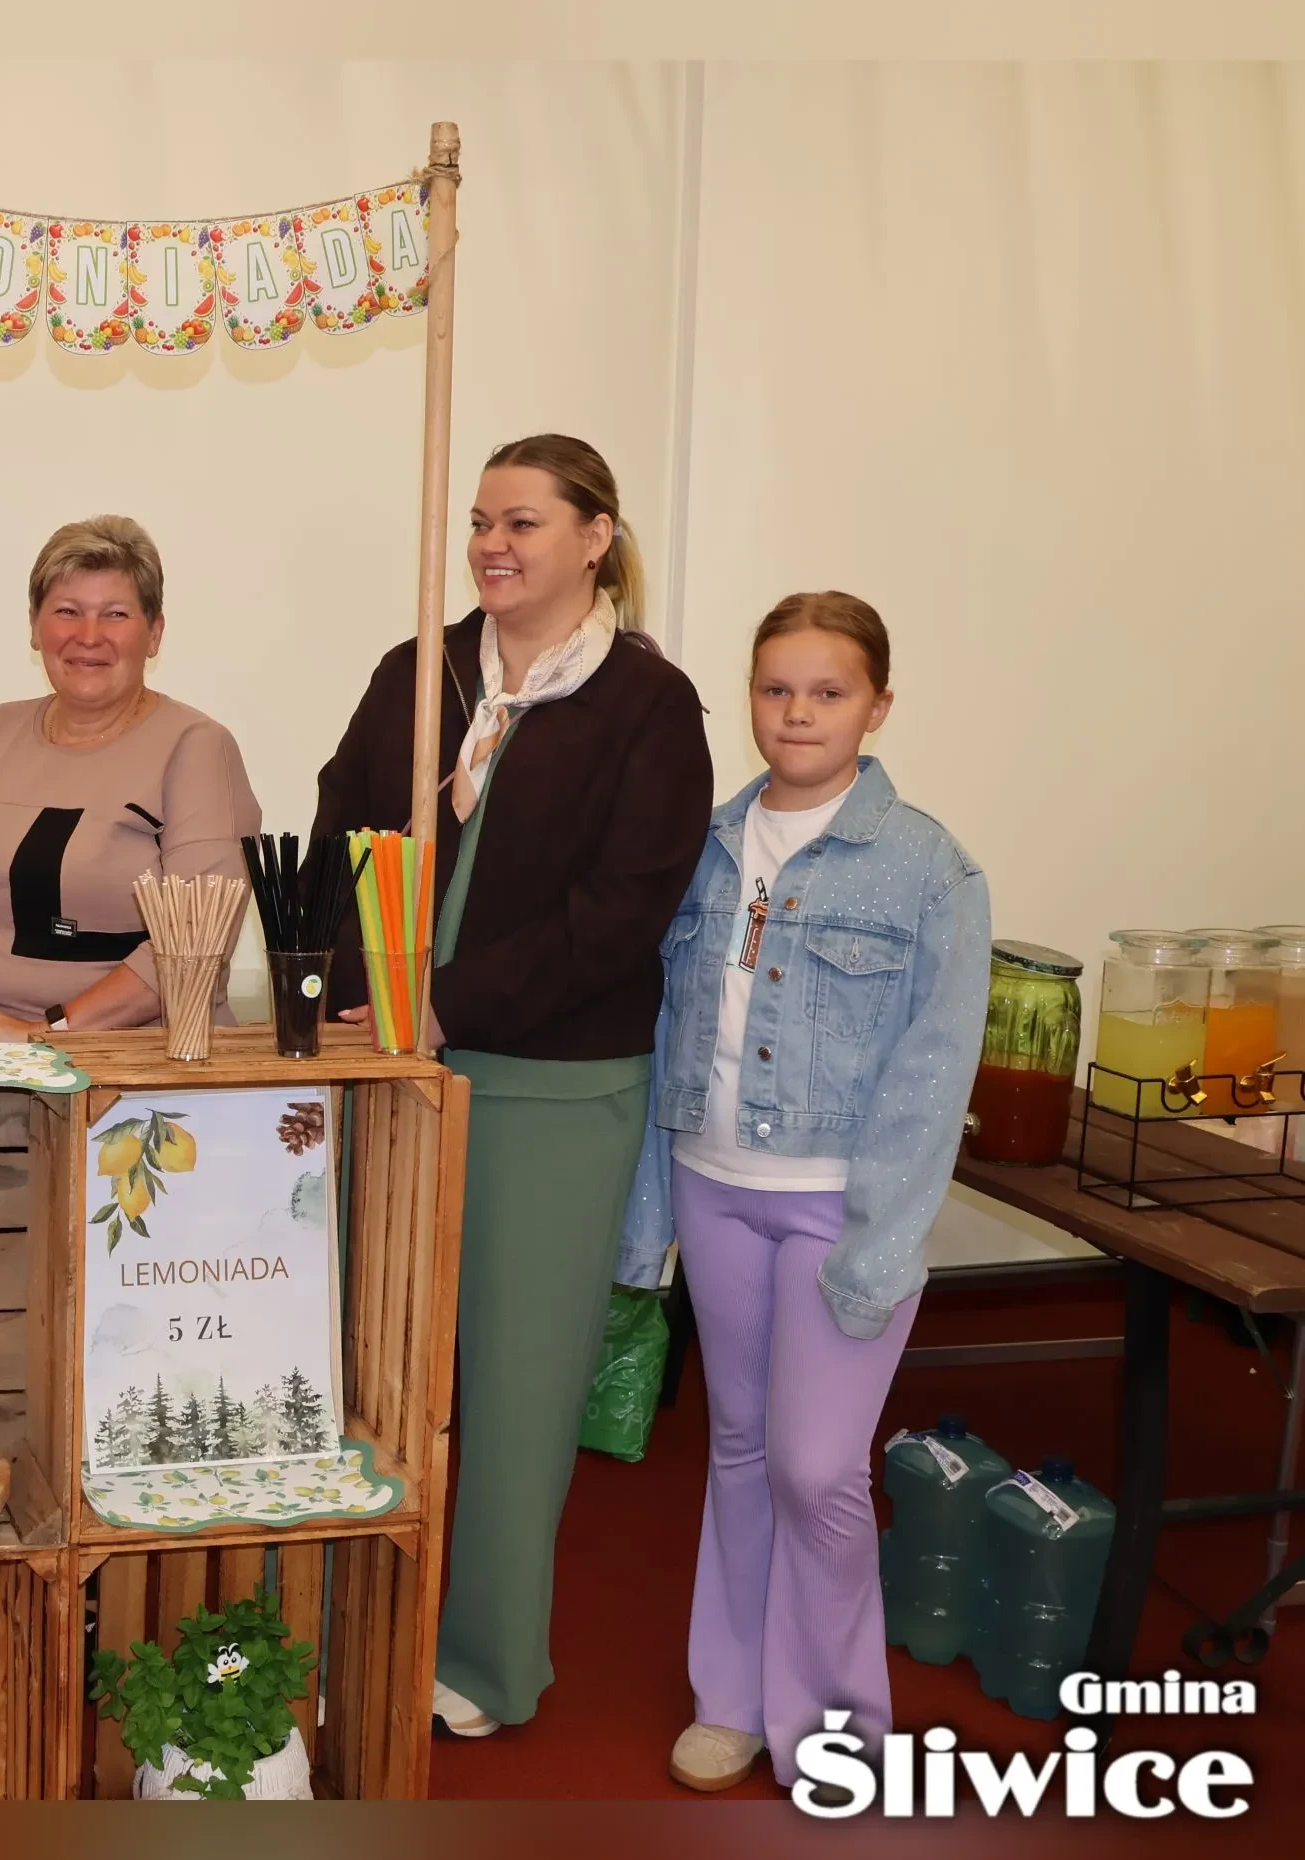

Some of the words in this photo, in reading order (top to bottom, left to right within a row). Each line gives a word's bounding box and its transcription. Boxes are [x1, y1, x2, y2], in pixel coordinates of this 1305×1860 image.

[121, 1256, 289, 1287] LEMONIADA
[168, 1315, 184, 1342] 5
[196, 1315, 233, 1340] ZŁ
